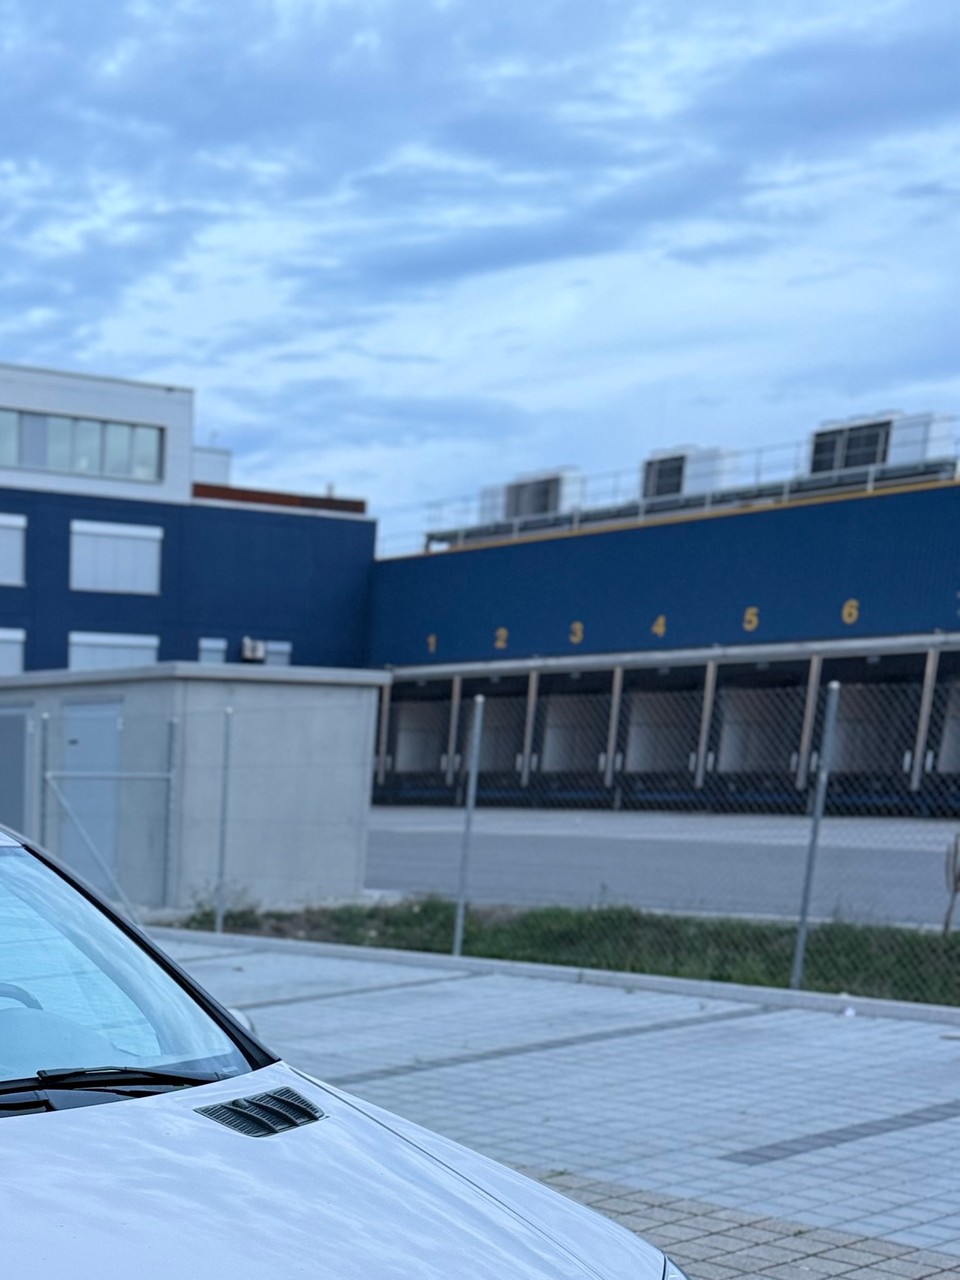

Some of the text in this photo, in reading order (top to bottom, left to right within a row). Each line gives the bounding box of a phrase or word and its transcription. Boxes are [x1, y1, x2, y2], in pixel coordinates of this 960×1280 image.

[743, 606, 759, 632] 5
[842, 598, 859, 625] 6
[569, 621, 584, 645] 3
[651, 614, 666, 637] 4
[427, 633, 437, 655] 1
[494, 626, 509, 650] 2
